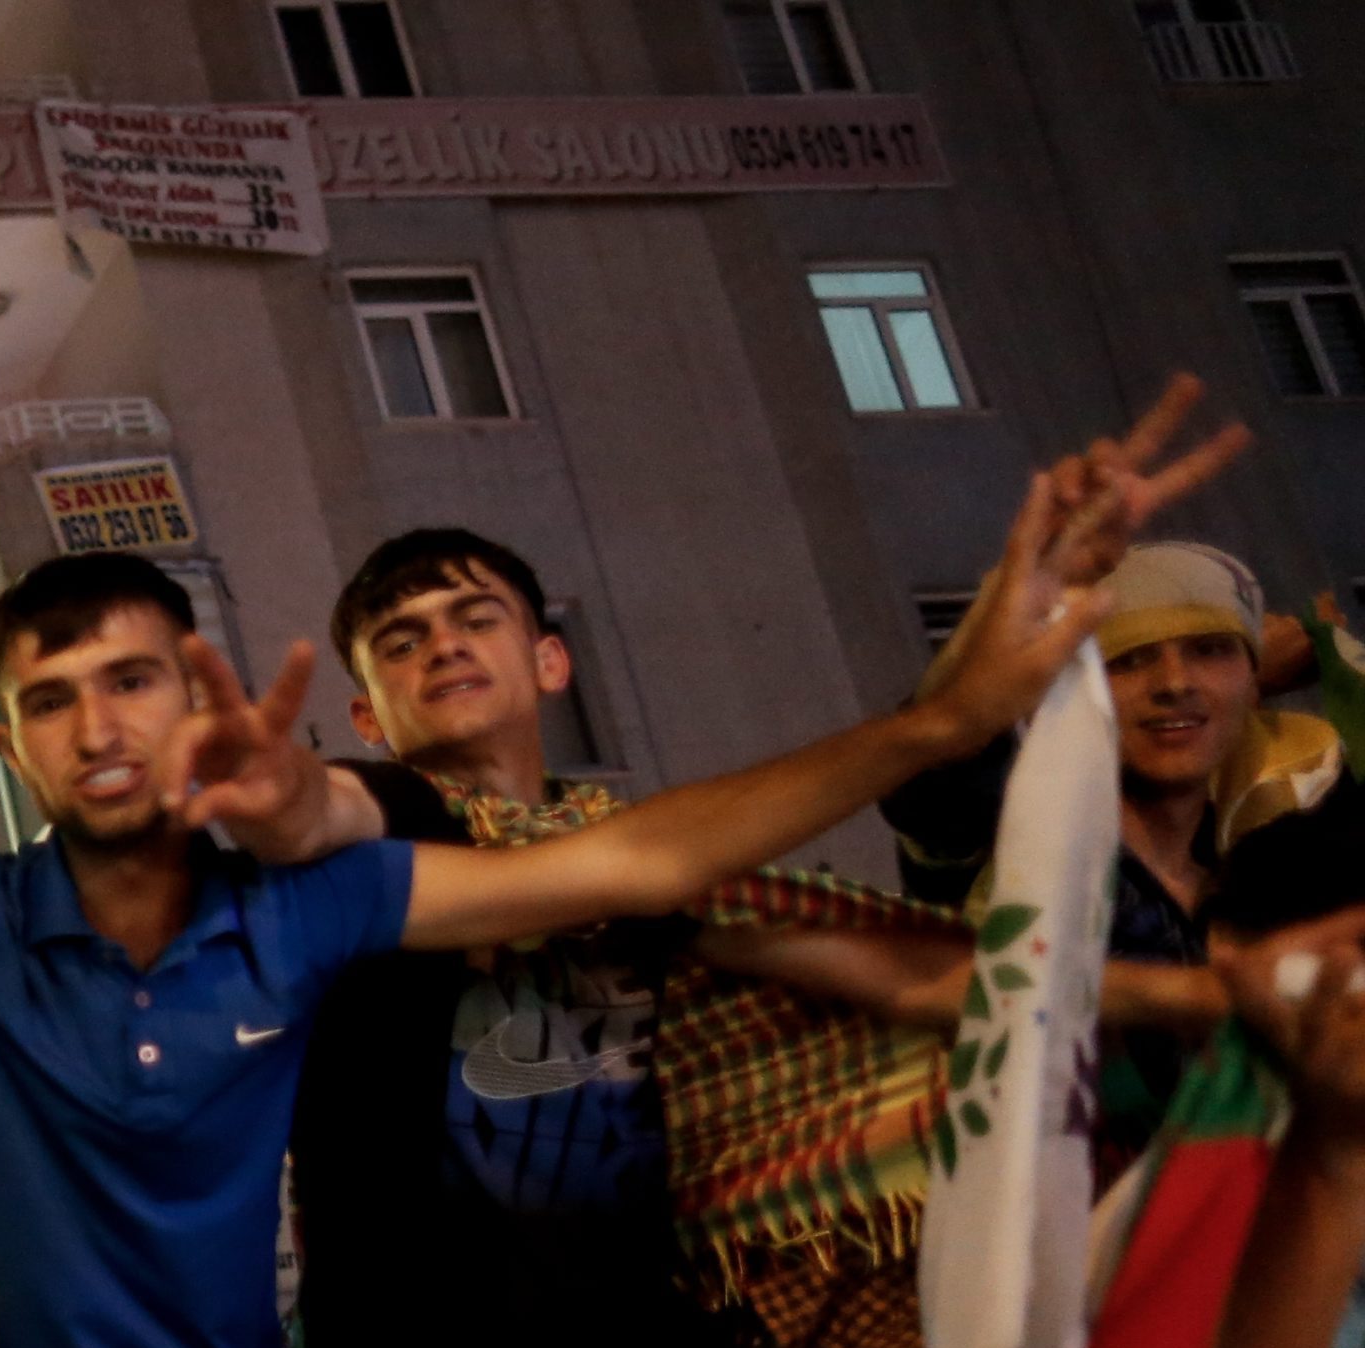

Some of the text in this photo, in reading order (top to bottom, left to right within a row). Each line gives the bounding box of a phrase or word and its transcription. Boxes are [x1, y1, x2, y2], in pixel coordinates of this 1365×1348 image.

[532, 120, 733, 184] SALONU
[730, 124, 796, 171] 0534
[804, 124, 851, 170] 619
[848, 122, 886, 168] 74
[888, 121, 922, 167] 17
[50, 474, 172, 512] SATILIK
